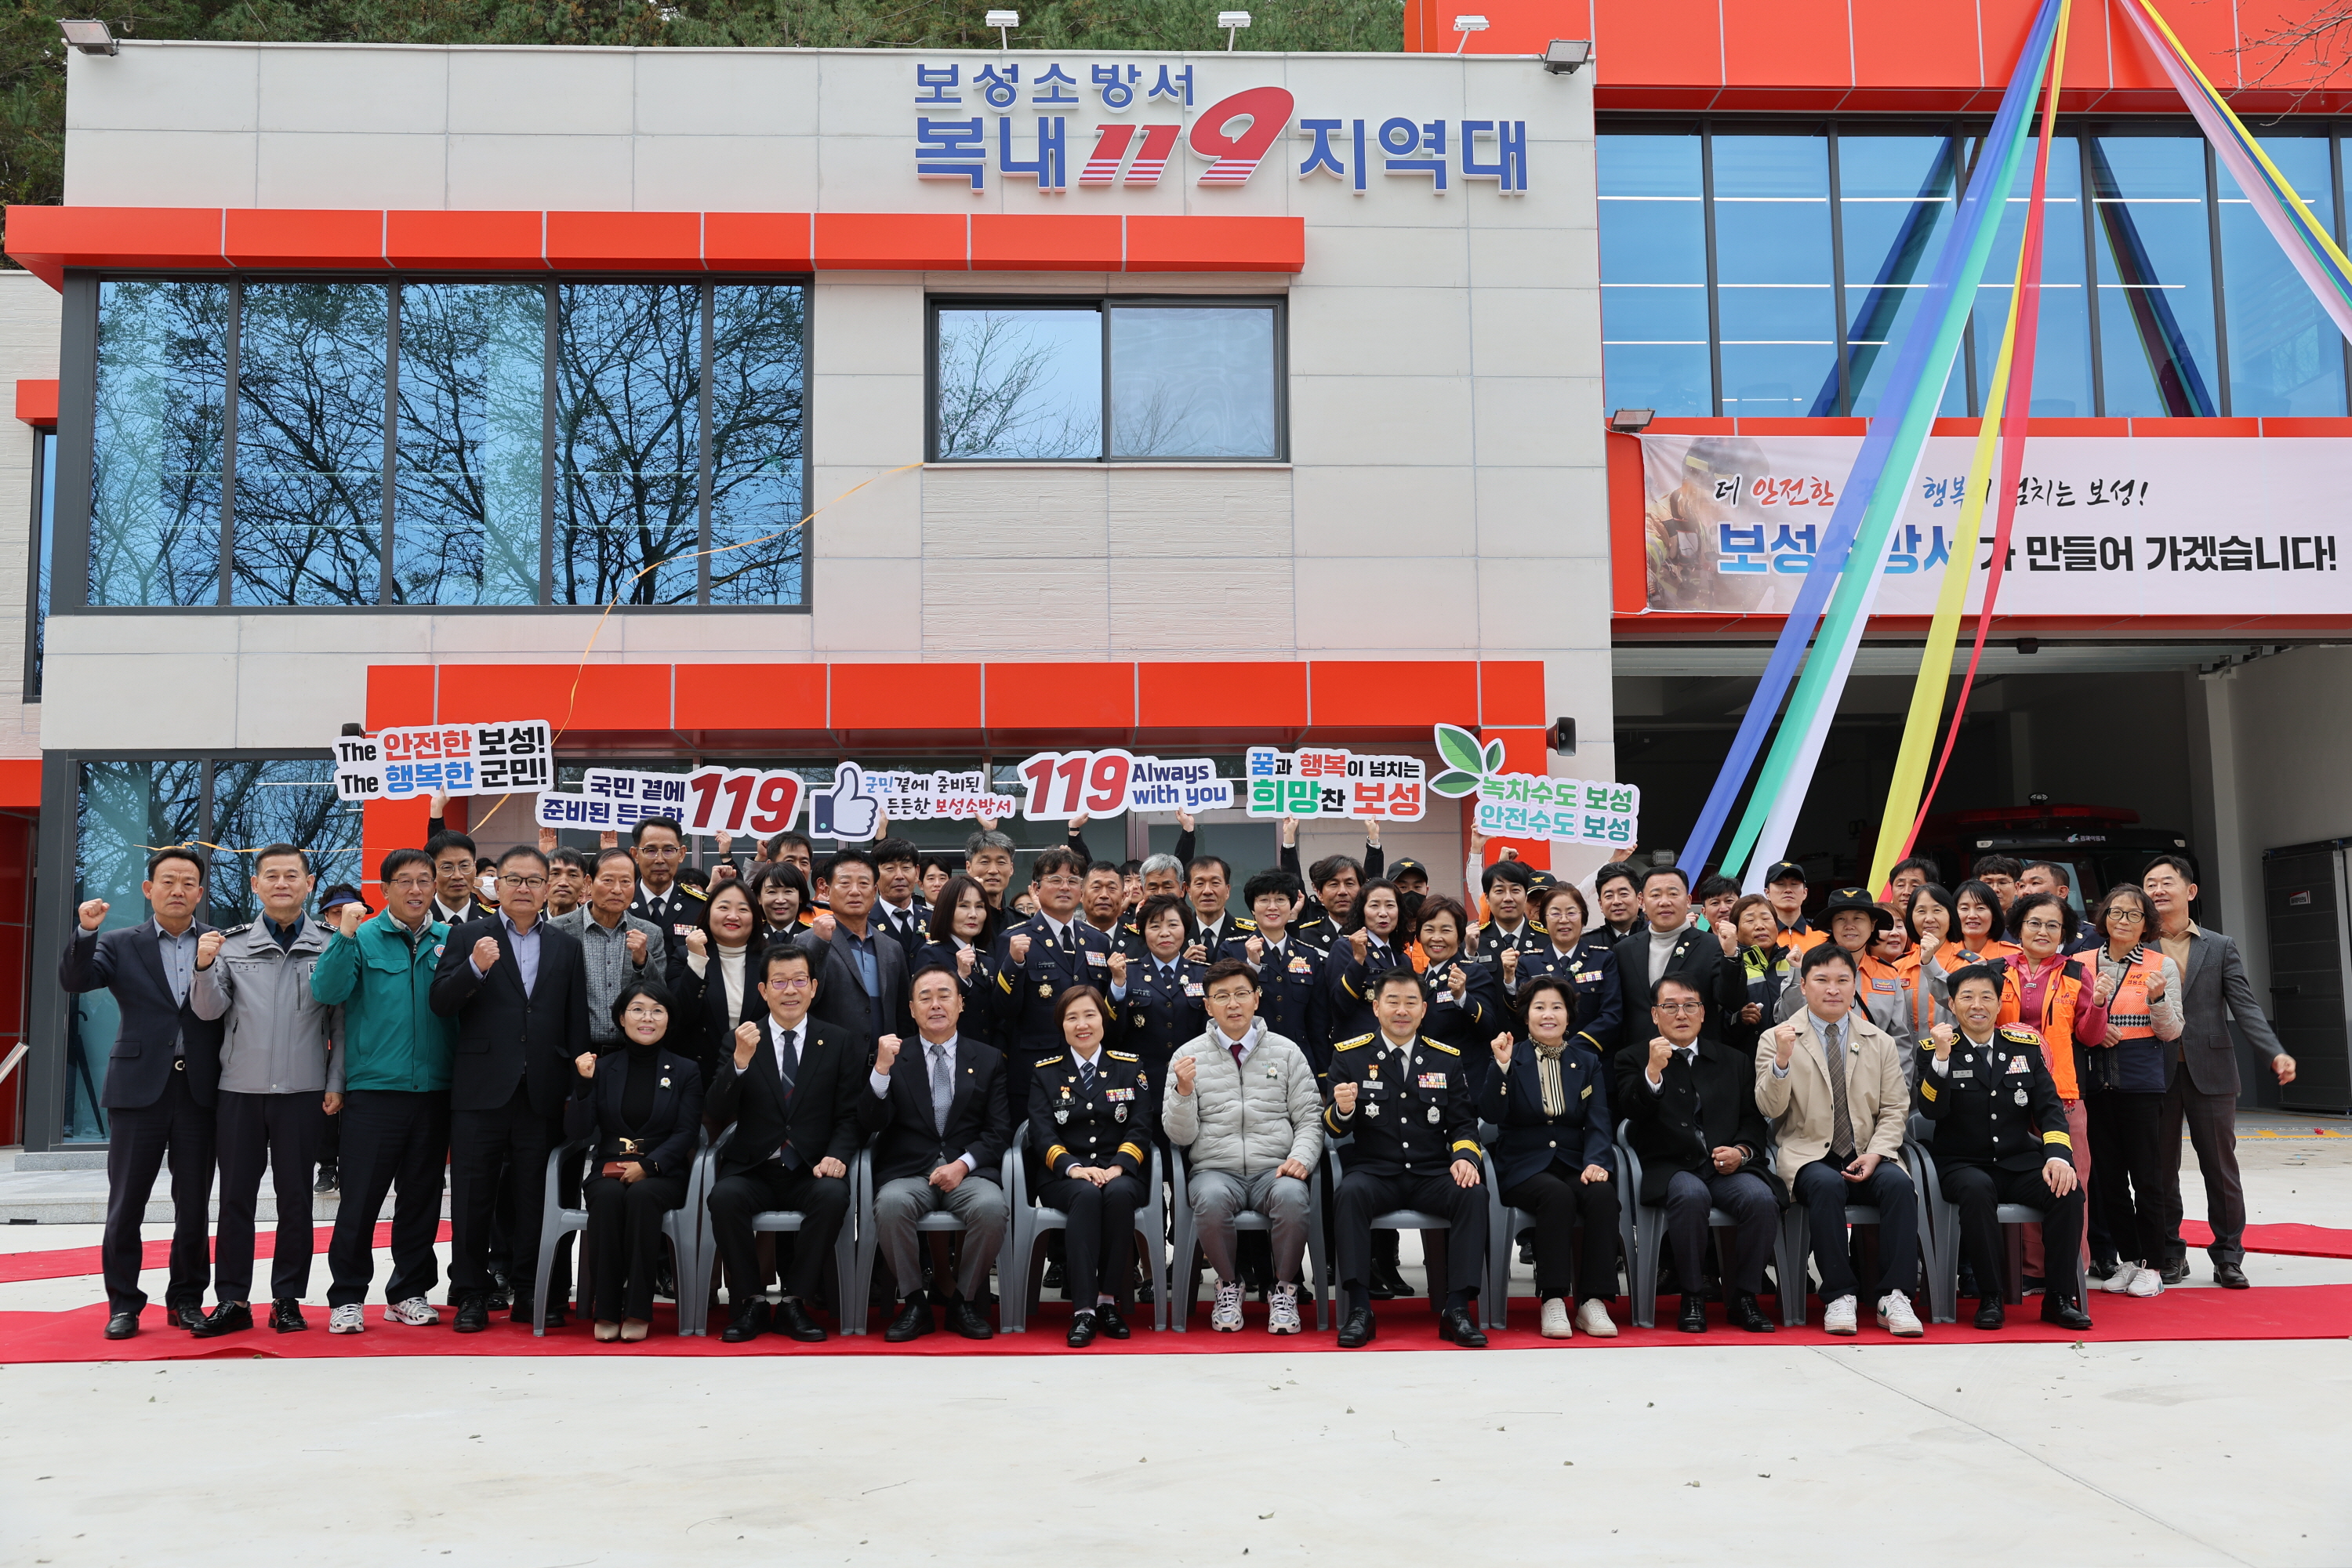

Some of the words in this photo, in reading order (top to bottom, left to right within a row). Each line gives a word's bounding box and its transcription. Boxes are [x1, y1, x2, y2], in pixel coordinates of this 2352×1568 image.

[914, 64, 1195, 111] 보성소방서
[1715, 476, 1740, 506] 더
[2005, 476, 2076, 507] 넘치는
[2086, 478, 2149, 506] 보성!
[2026, 536, 2134, 572] 만들어
[2146, 535, 2337, 572] 가겠습니다!
[338, 742, 377, 762] The
[383, 730, 472, 761] 안전한
[479, 727, 545, 756] 보성!
[340, 774, 379, 793] The
[385, 761, 474, 793] 행복한
[480, 758, 547, 788] 군민!
[1131, 763, 1210, 785] Always
[1251, 753, 1292, 776] 꿈과
[1300, 753, 1363, 778] 행복이
[1370, 760, 1420, 779] 넘치는
[590, 775, 635, 799] 국민
[642, 779, 686, 802] 곁에
[866, 776, 929, 793] 군민곁에
[938, 775, 980, 793] 준비된
[1024, 755, 1130, 813] 119
[1132, 784, 1179, 805] with
[1185, 786, 1227, 807] you
[1252, 779, 1346, 813] 희망찬
[1353, 782, 1421, 816] 보성
[1482, 775, 1577, 808] 녹차수도
[1584, 786, 1632, 813] 보성
[543, 799, 611, 824] 준비된
[690, 773, 798, 833] 119
[887, 797, 931, 815] 든든한
[935, 797, 1011, 815] 보성소방서
[1480, 804, 1575, 836] 안전수도
[1582, 815, 1631, 842] 보성
